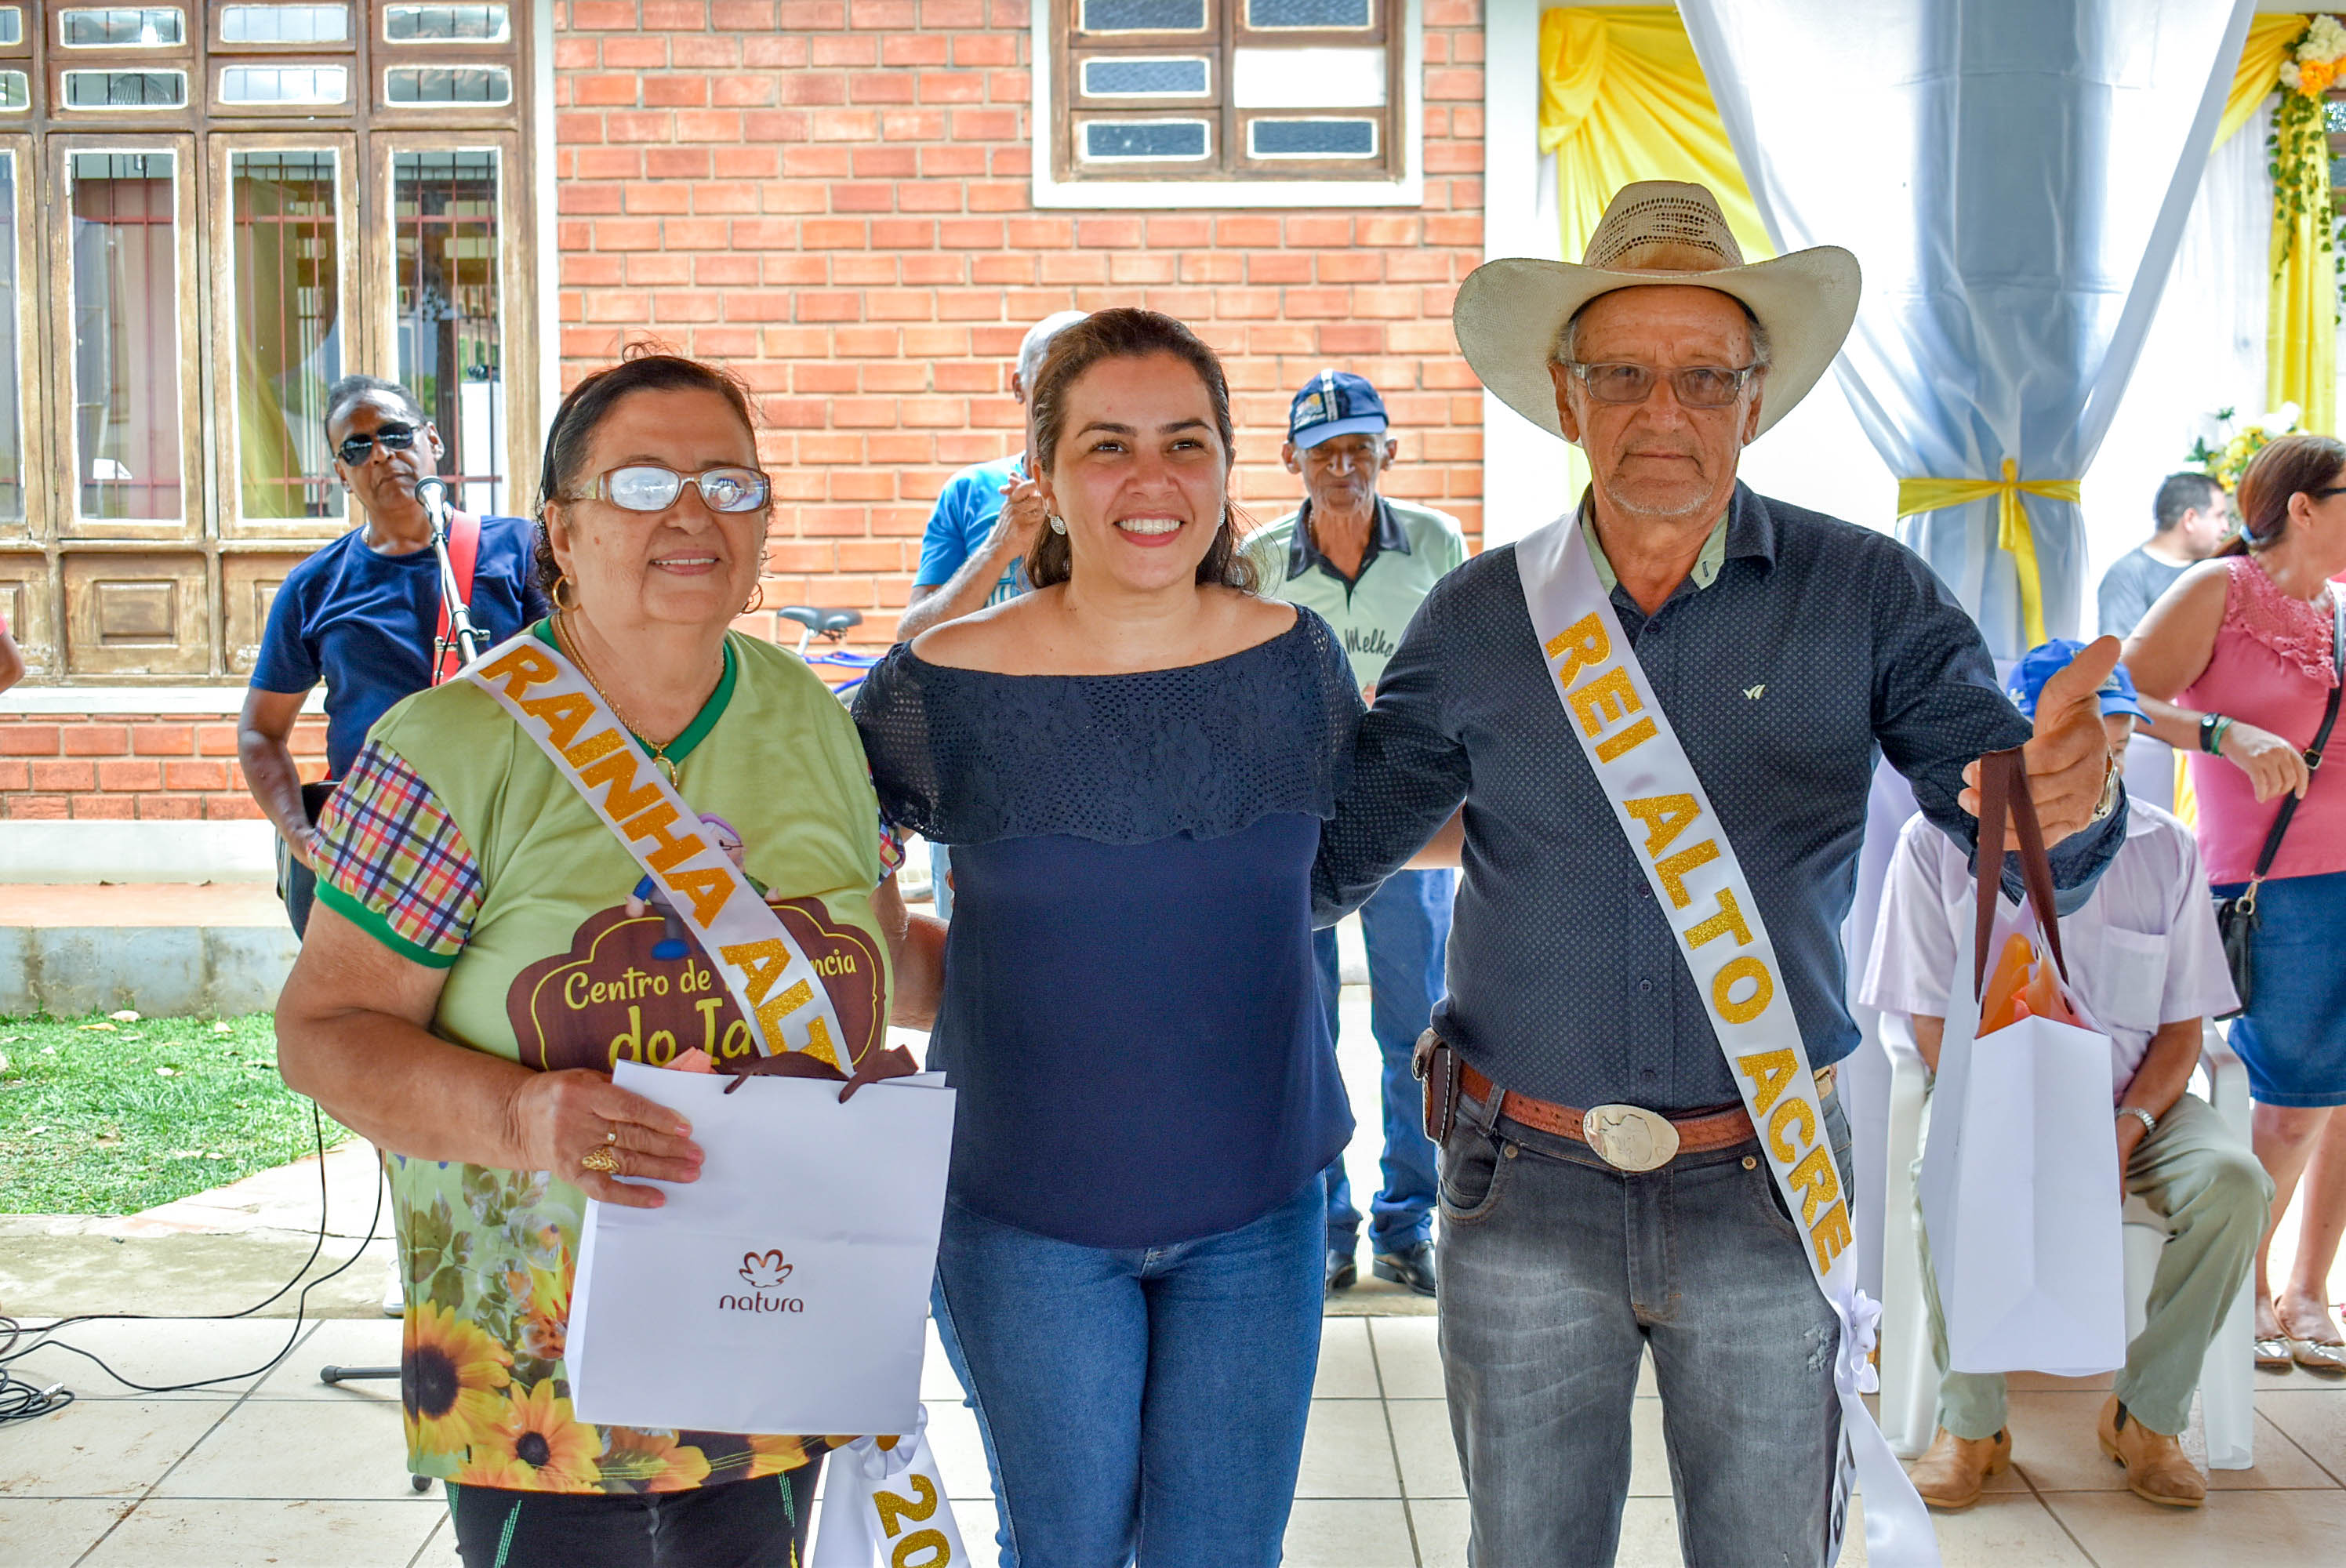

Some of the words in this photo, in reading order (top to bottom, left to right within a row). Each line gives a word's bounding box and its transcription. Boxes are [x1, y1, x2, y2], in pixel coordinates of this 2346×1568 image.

[478, 644, 736, 931] RAINHA
[1545, 611, 1660, 764] REI
[1622, 792, 1774, 1024] ALTO
[1735, 1048, 1853, 1277] ACRE
[564, 966, 670, 1010] Centro
[680, 958, 712, 993] de
[608, 1004, 677, 1069] do
[718, 1291, 804, 1314] natura
